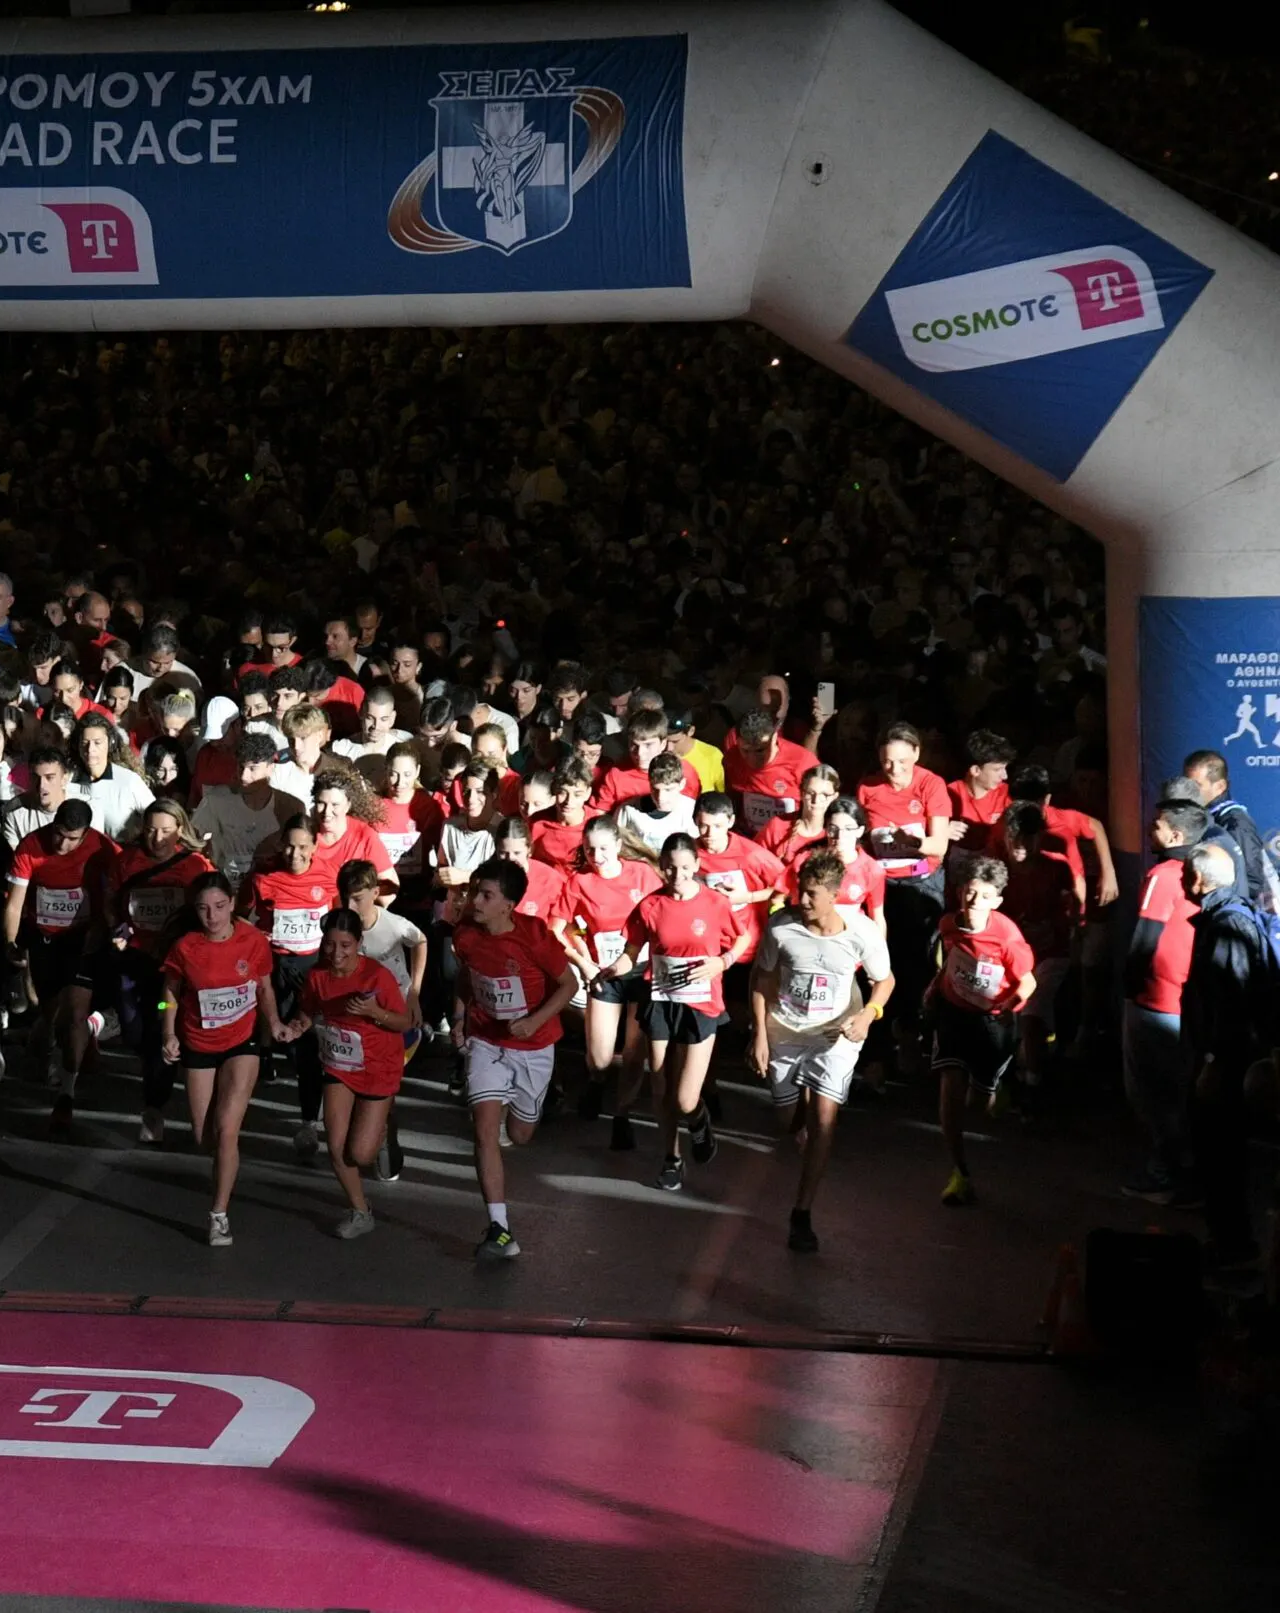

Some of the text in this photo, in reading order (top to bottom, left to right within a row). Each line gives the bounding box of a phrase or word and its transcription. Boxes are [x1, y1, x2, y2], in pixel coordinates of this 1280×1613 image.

[436, 67, 575, 99] ΣΕΓΑΣ
[92, 118, 240, 166] RACE
[912, 294, 1060, 343] COSMOTE
[1215, 653, 1280, 664] ΜΑΡΑΘΩ
[1236, 679, 1280, 688] ΑΥΘΕΝΤ
[45, 902, 81, 912] 75260
